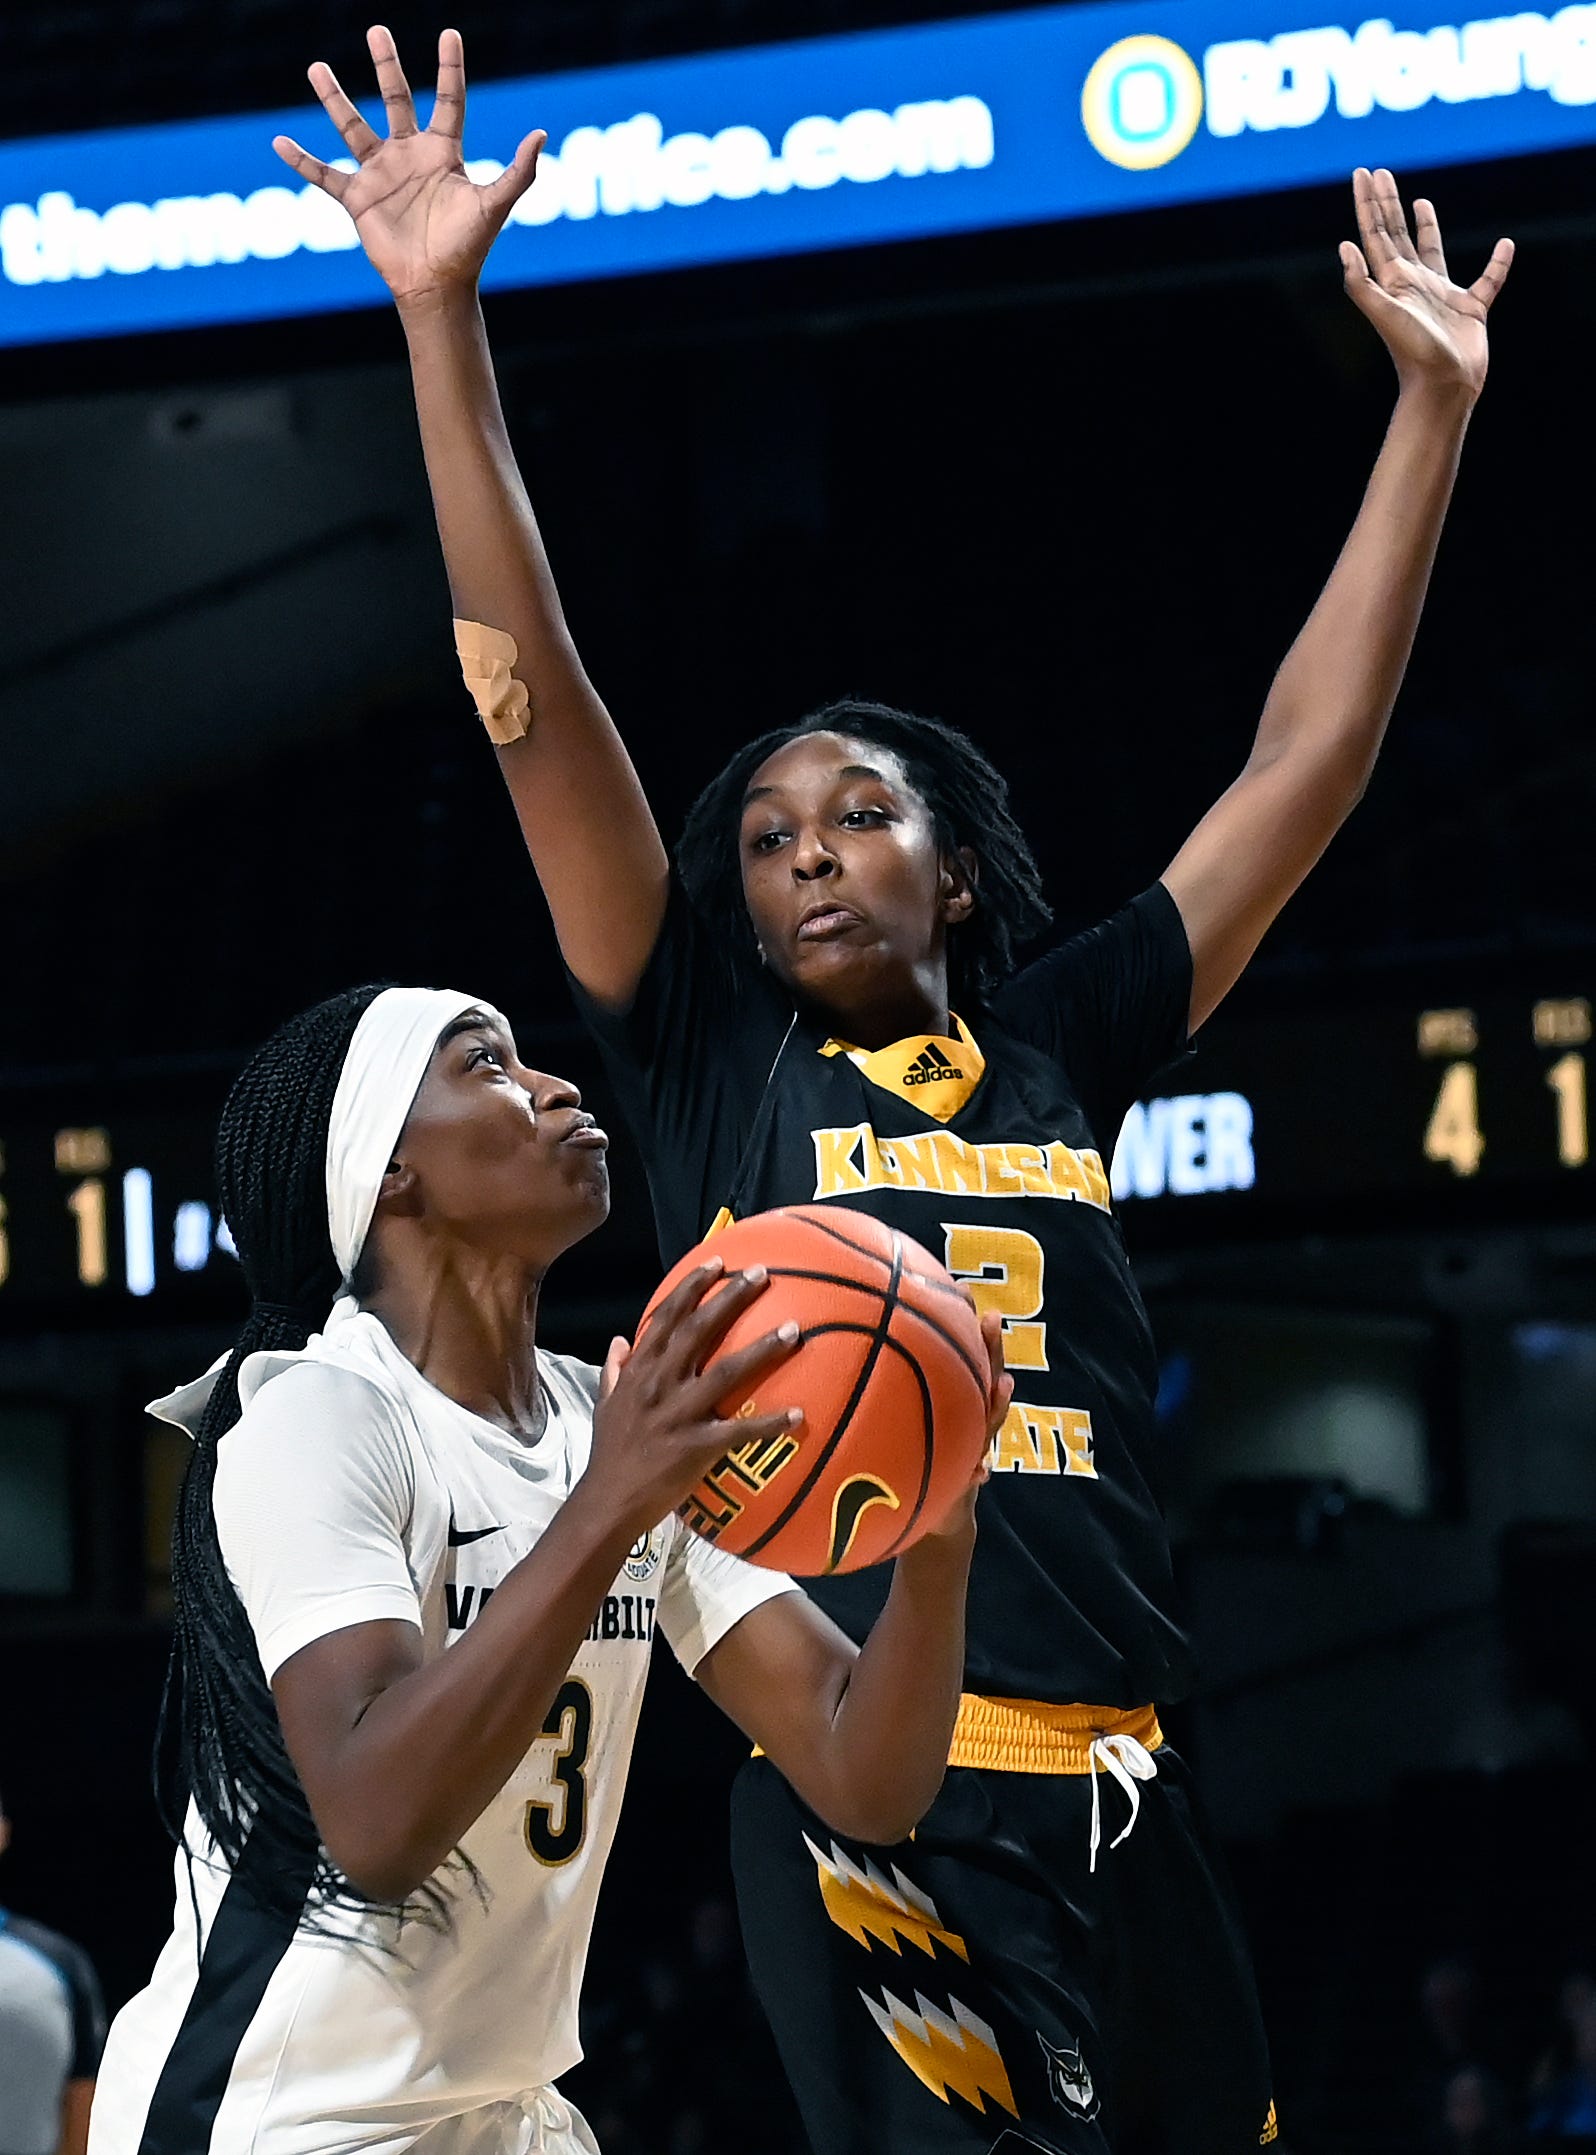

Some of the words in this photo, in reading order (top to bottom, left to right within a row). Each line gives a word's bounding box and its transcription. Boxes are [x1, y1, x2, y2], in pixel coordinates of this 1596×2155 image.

[902, 1066, 964, 1086] adidas
[1424, 1060, 1484, 1177] 4
[1547, 1052, 1588, 1168] 1
[68, 1178, 108, 1287] 1
[939, 1222, 1050, 1372] 2
[984, 1402, 1099, 1480] ATE
[523, 1675, 593, 1867] 3
